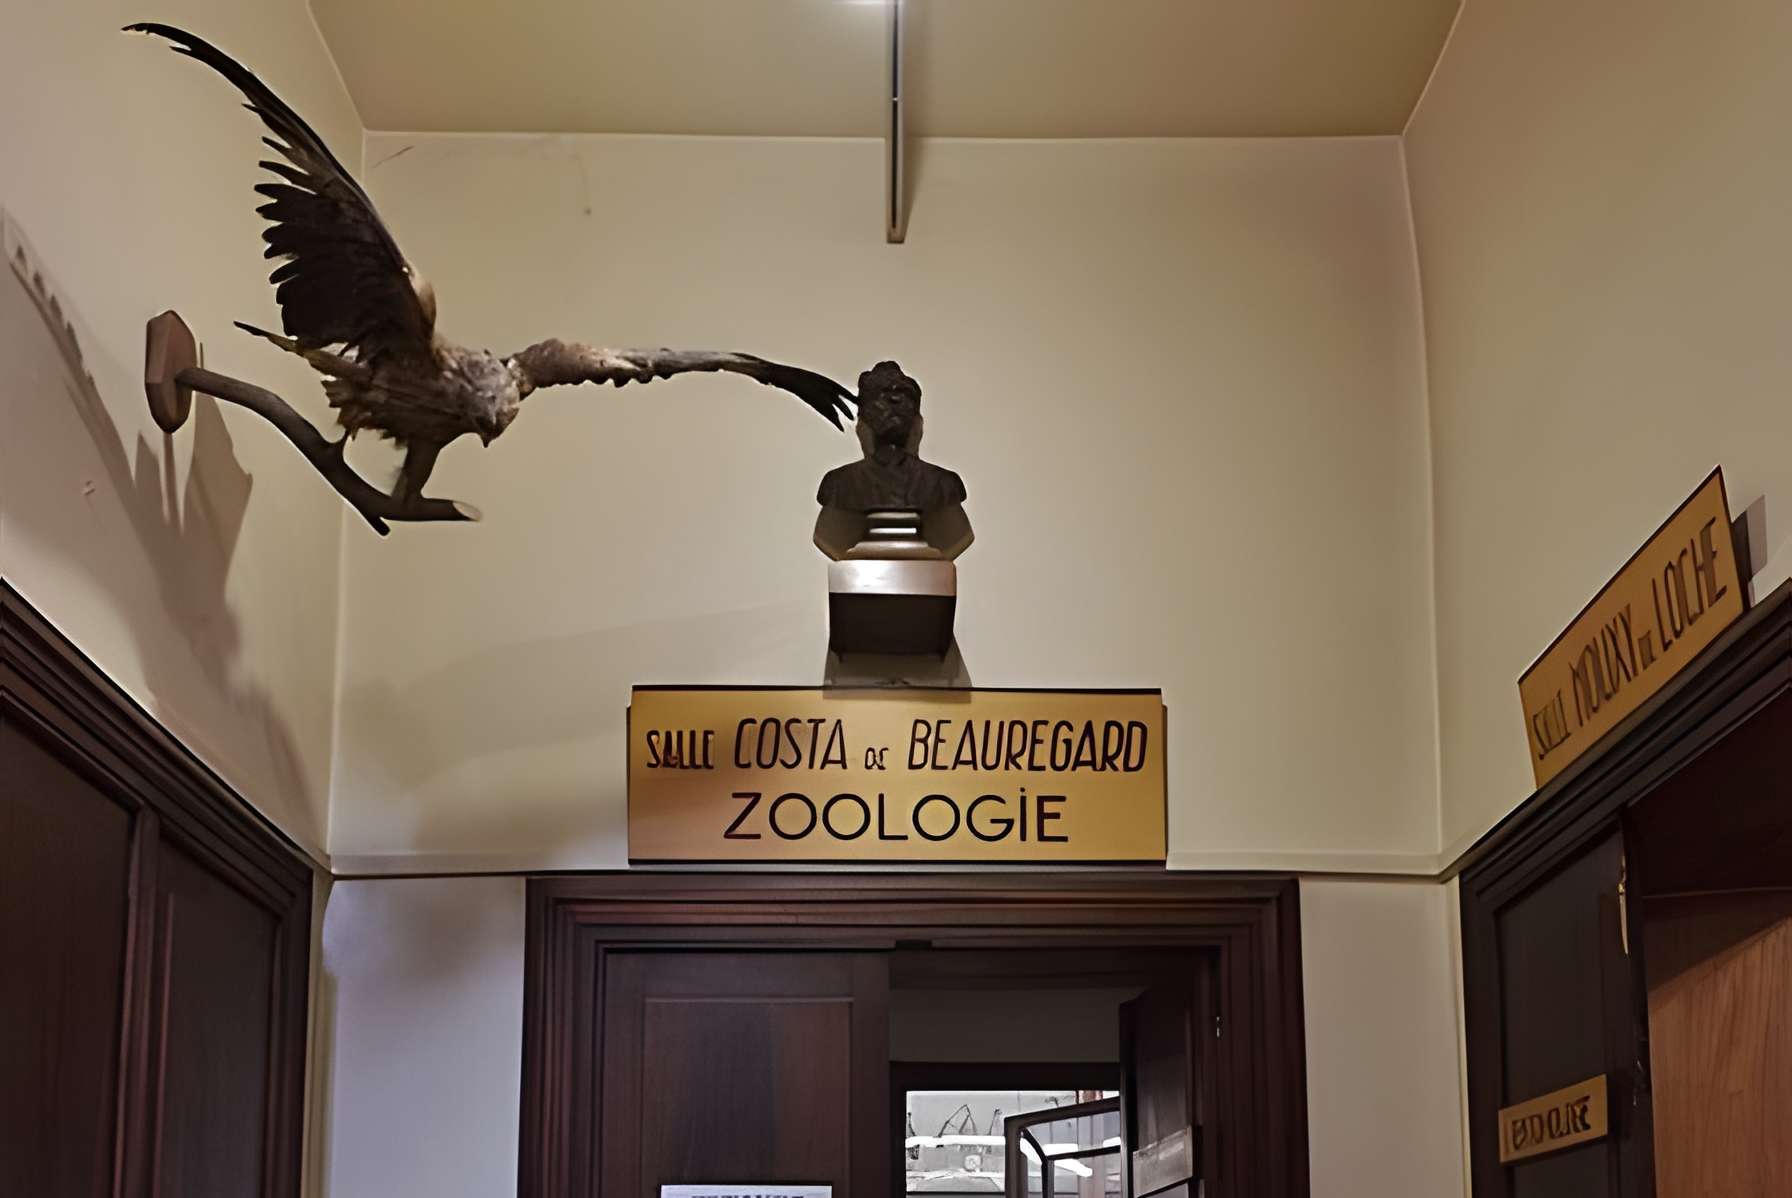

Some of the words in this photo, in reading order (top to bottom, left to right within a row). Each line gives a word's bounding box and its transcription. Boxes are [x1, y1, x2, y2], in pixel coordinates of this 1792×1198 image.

[1652, 516, 1727, 651] LOCHE
[646, 730, 715, 770] SALLE
[734, 717, 848, 770] COSTA
[907, 718, 1148, 773] BEAUREGARD
